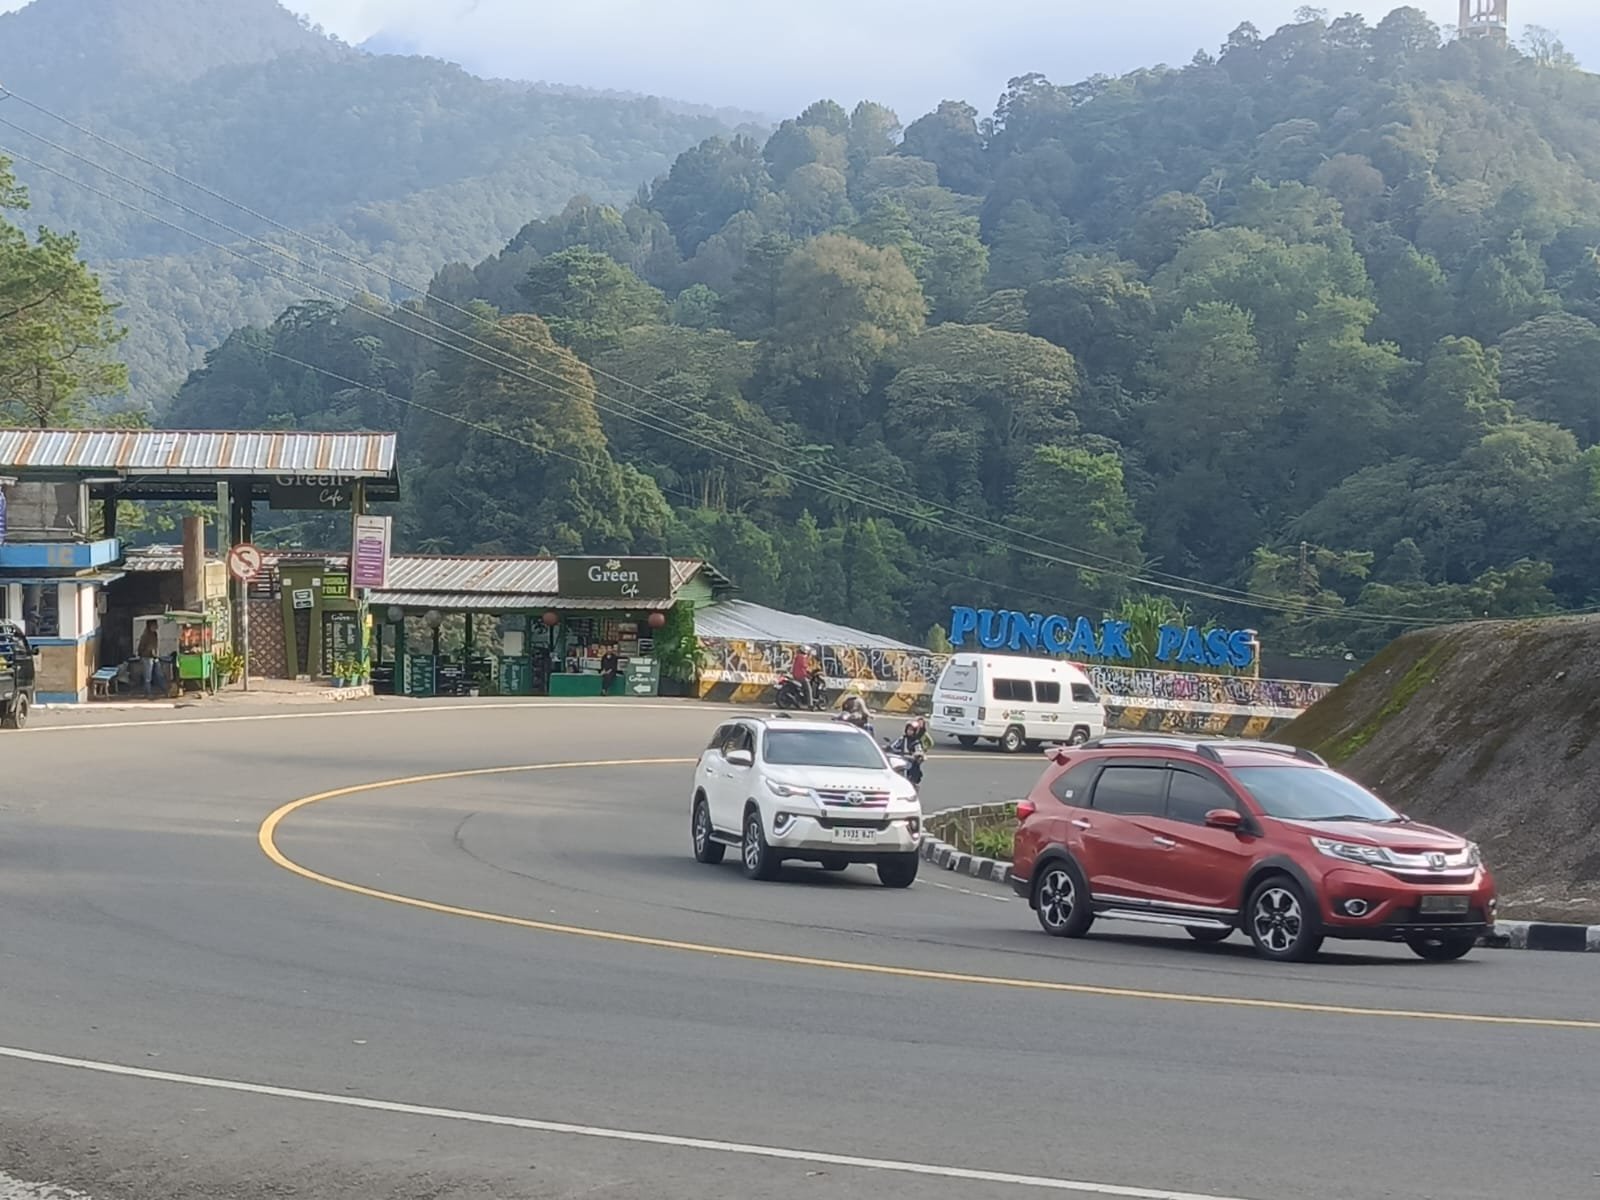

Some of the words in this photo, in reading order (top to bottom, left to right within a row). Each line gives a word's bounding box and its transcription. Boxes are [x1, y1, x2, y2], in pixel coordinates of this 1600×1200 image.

[587, 566, 639, 582] Green
[322, 586, 346, 594] TOILET
[621, 583, 639, 599] Cafe
[950, 606, 1131, 658] PUNCAK
[1155, 624, 1255, 668] PASS
